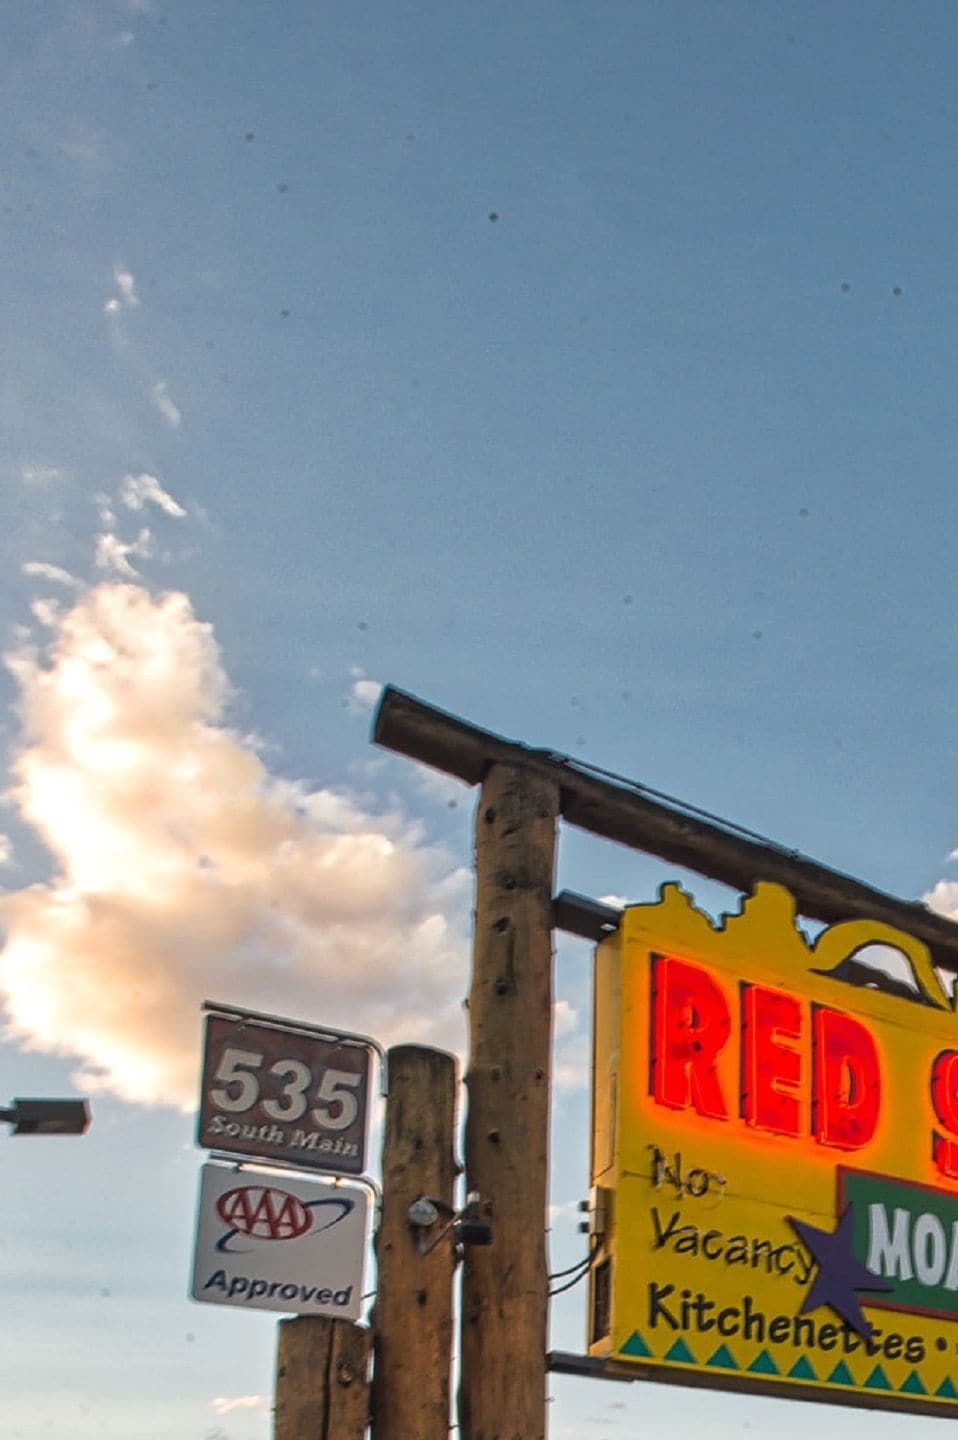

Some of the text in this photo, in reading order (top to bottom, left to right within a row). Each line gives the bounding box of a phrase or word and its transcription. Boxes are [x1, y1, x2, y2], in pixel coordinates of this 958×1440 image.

[210, 1048, 362, 1130] 535
[648, 951, 881, 1152] RED
[208, 1115, 359, 1157] South Main
[218, 1188, 309, 1240] AAA
[650, 1207, 818, 1286] Vacancy
[205, 1269, 353, 1308] Approved
[646, 1282, 928, 1364] Kitchenettes
